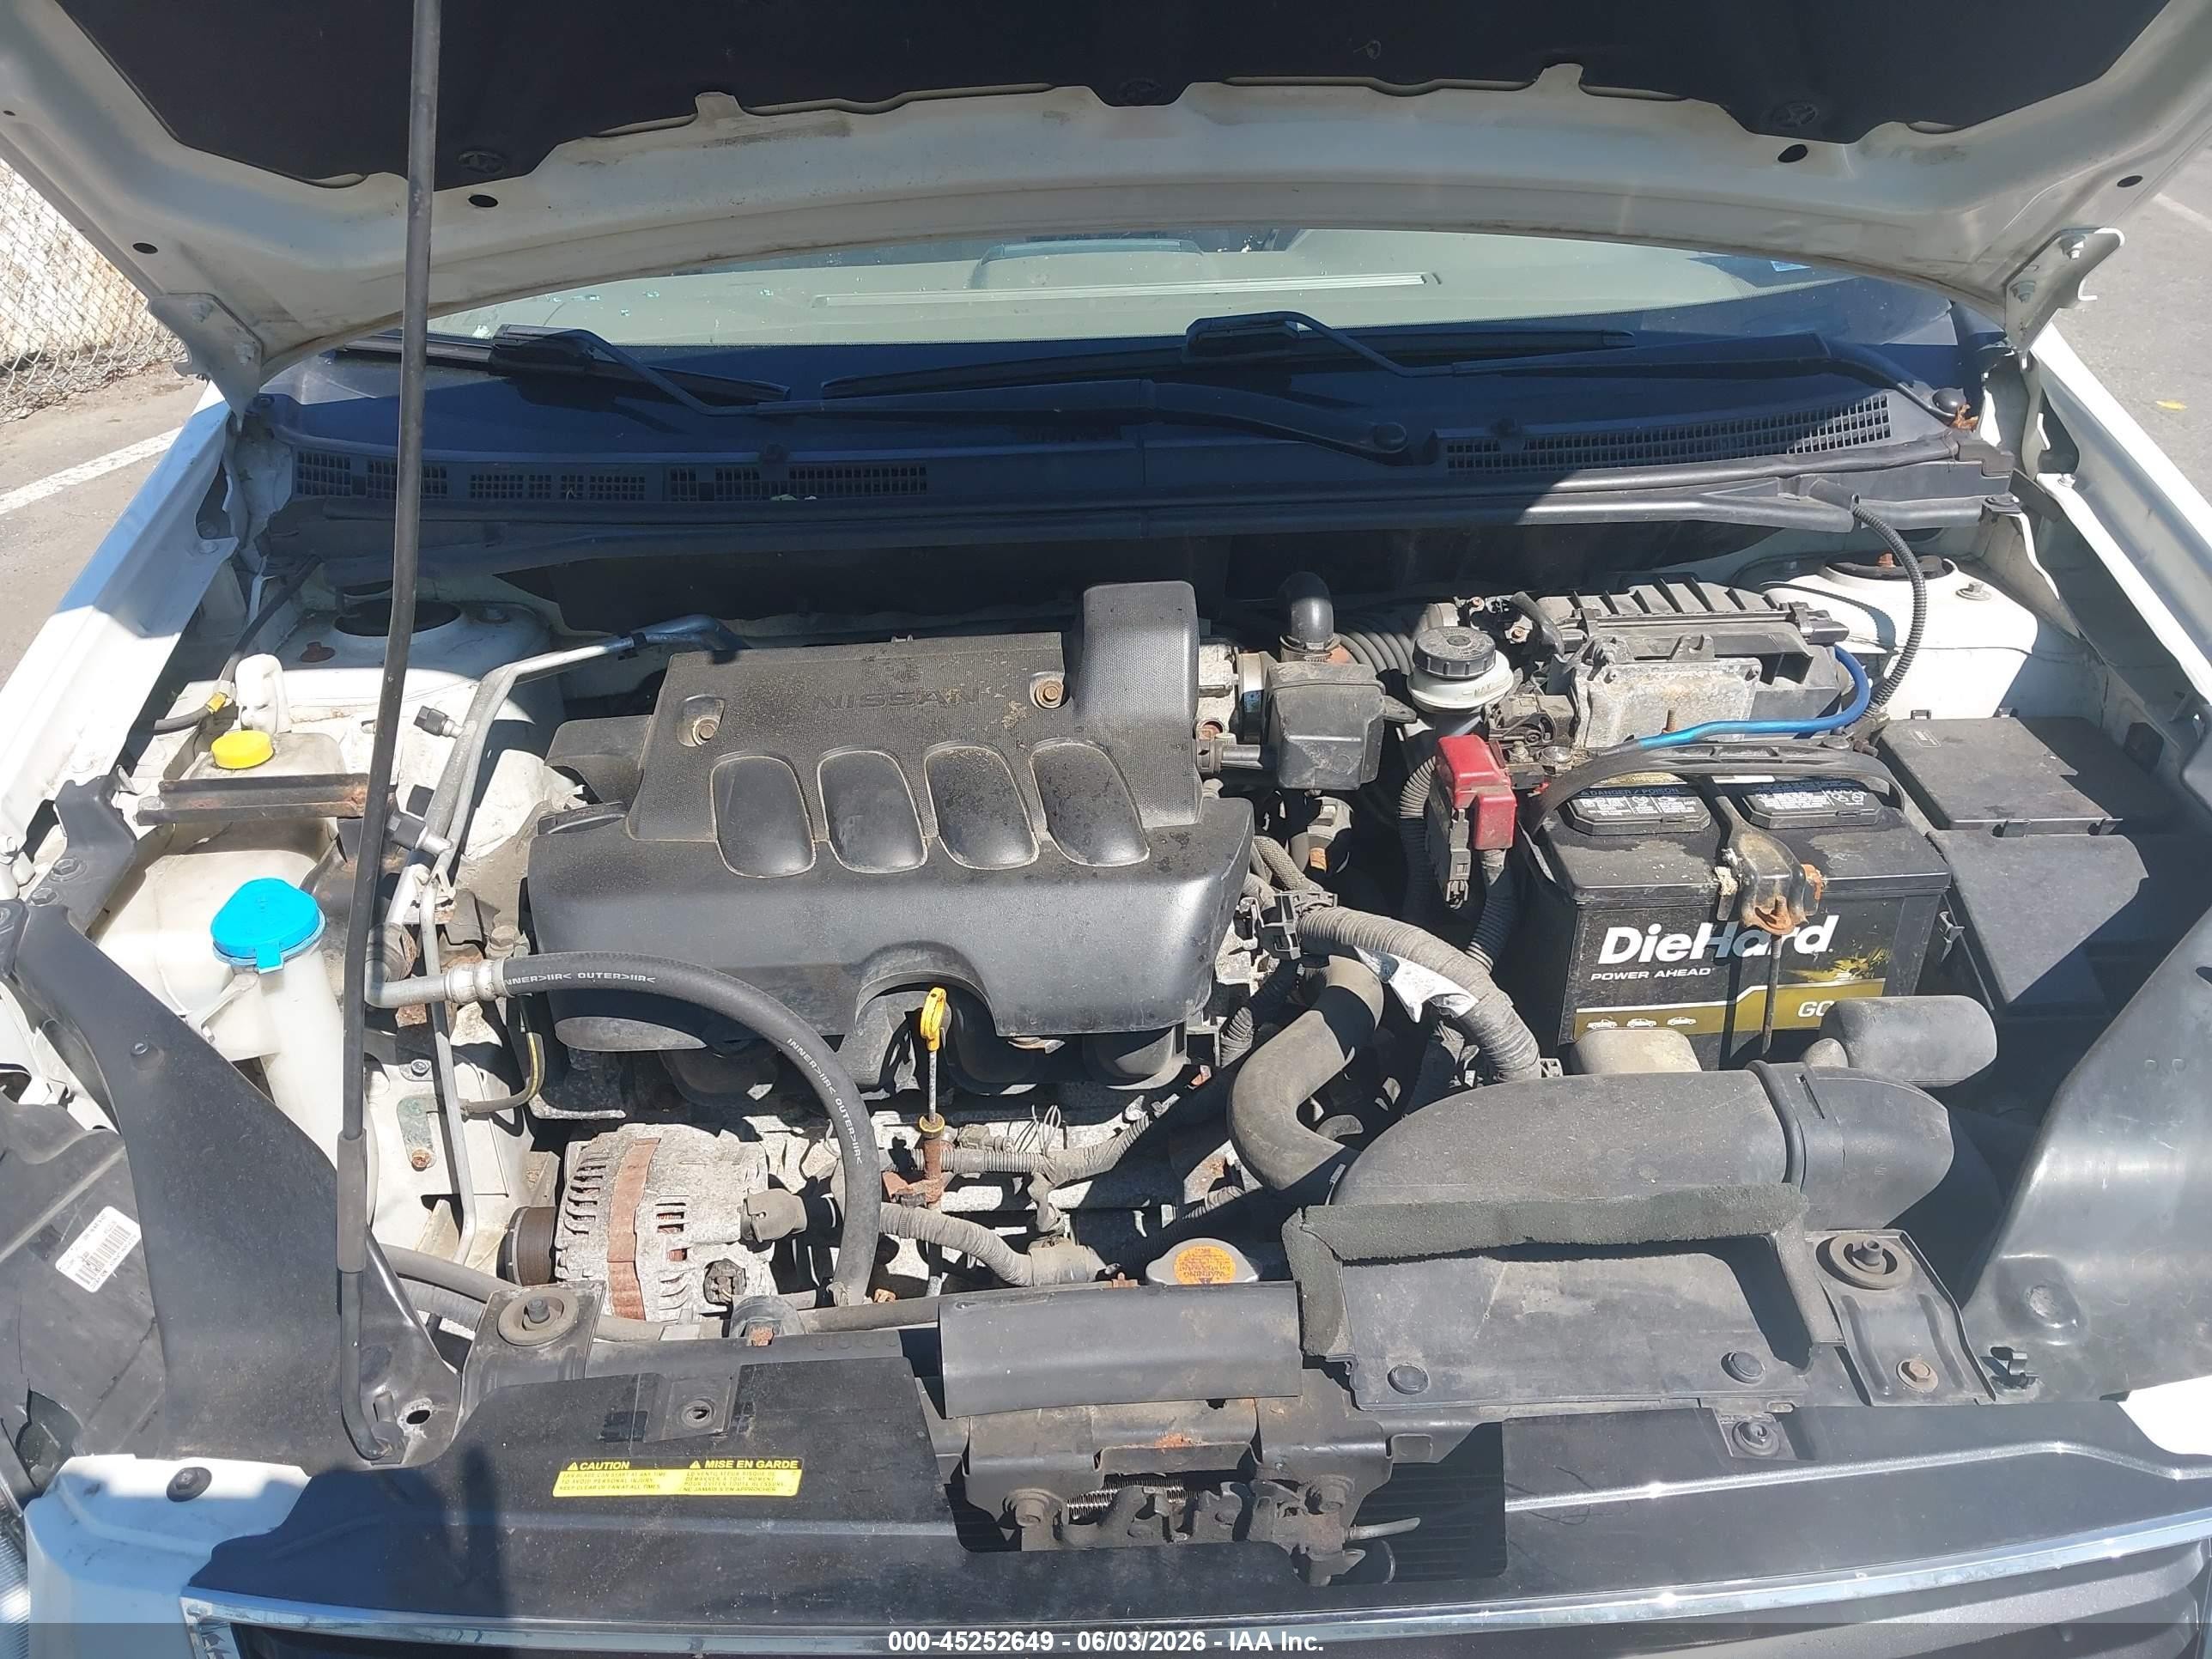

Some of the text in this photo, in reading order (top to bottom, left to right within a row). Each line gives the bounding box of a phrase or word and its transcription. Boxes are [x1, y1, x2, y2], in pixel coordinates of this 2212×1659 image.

[811, 688, 979, 711] NISSAN
[1590, 787, 1632, 796] DANGER
[1597, 915, 1840, 964] DieHard
[1590, 968, 1711, 981] POWER AHEAD
[580, 1462, 629, 1470] CAUTION
